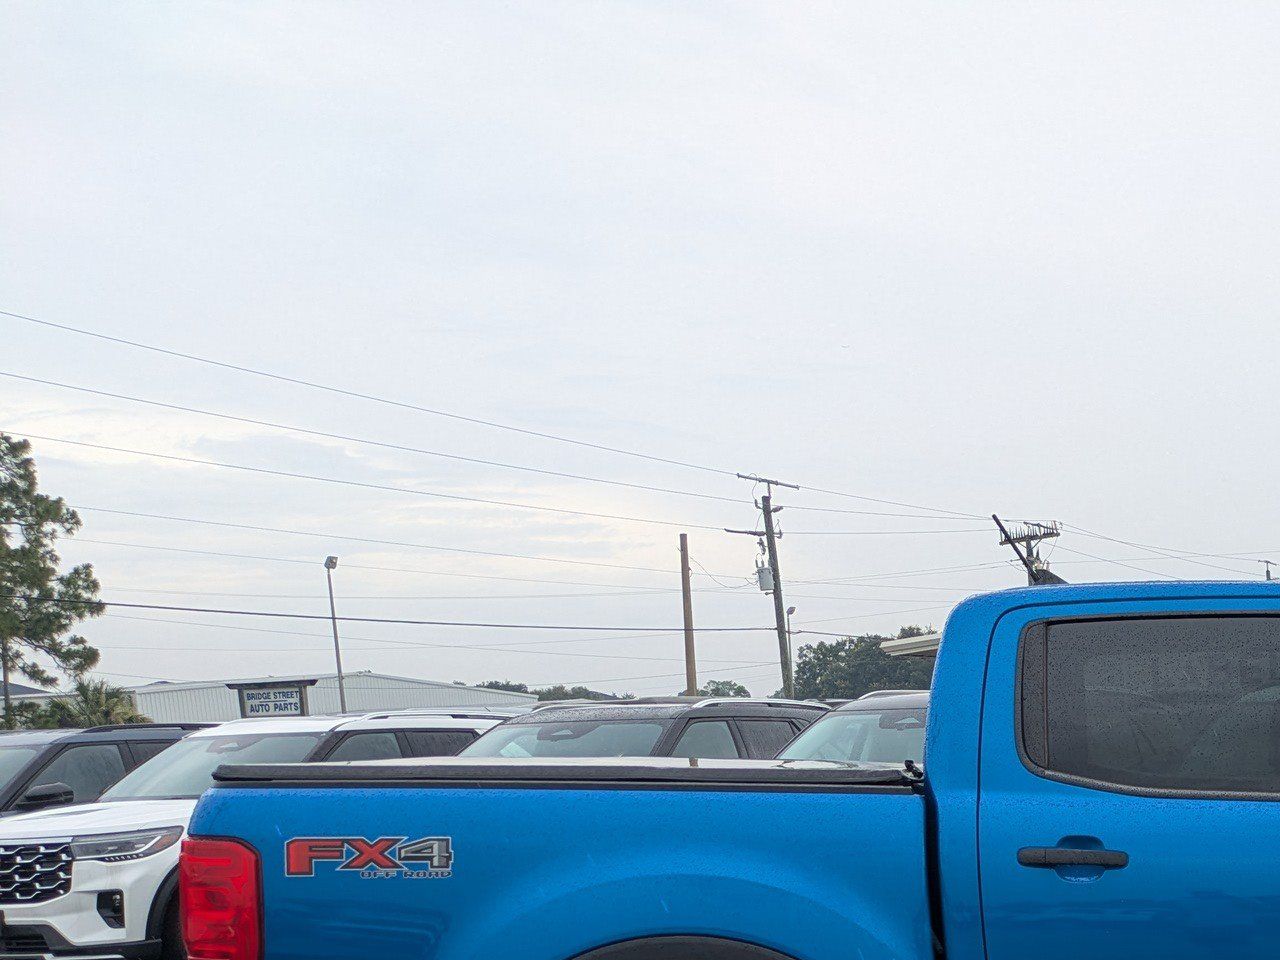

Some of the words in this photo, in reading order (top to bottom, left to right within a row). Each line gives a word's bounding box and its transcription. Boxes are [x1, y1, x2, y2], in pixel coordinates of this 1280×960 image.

[247, 692, 271, 701] BRIDGE
[274, 691, 299, 699] STREET
[250, 703, 270, 713] AUTO
[274, 702, 299, 712] PARTS
[285, 836, 454, 877] FX4
[360, 870, 397, 879] OFF
[403, 870, 452, 879] ROAD
